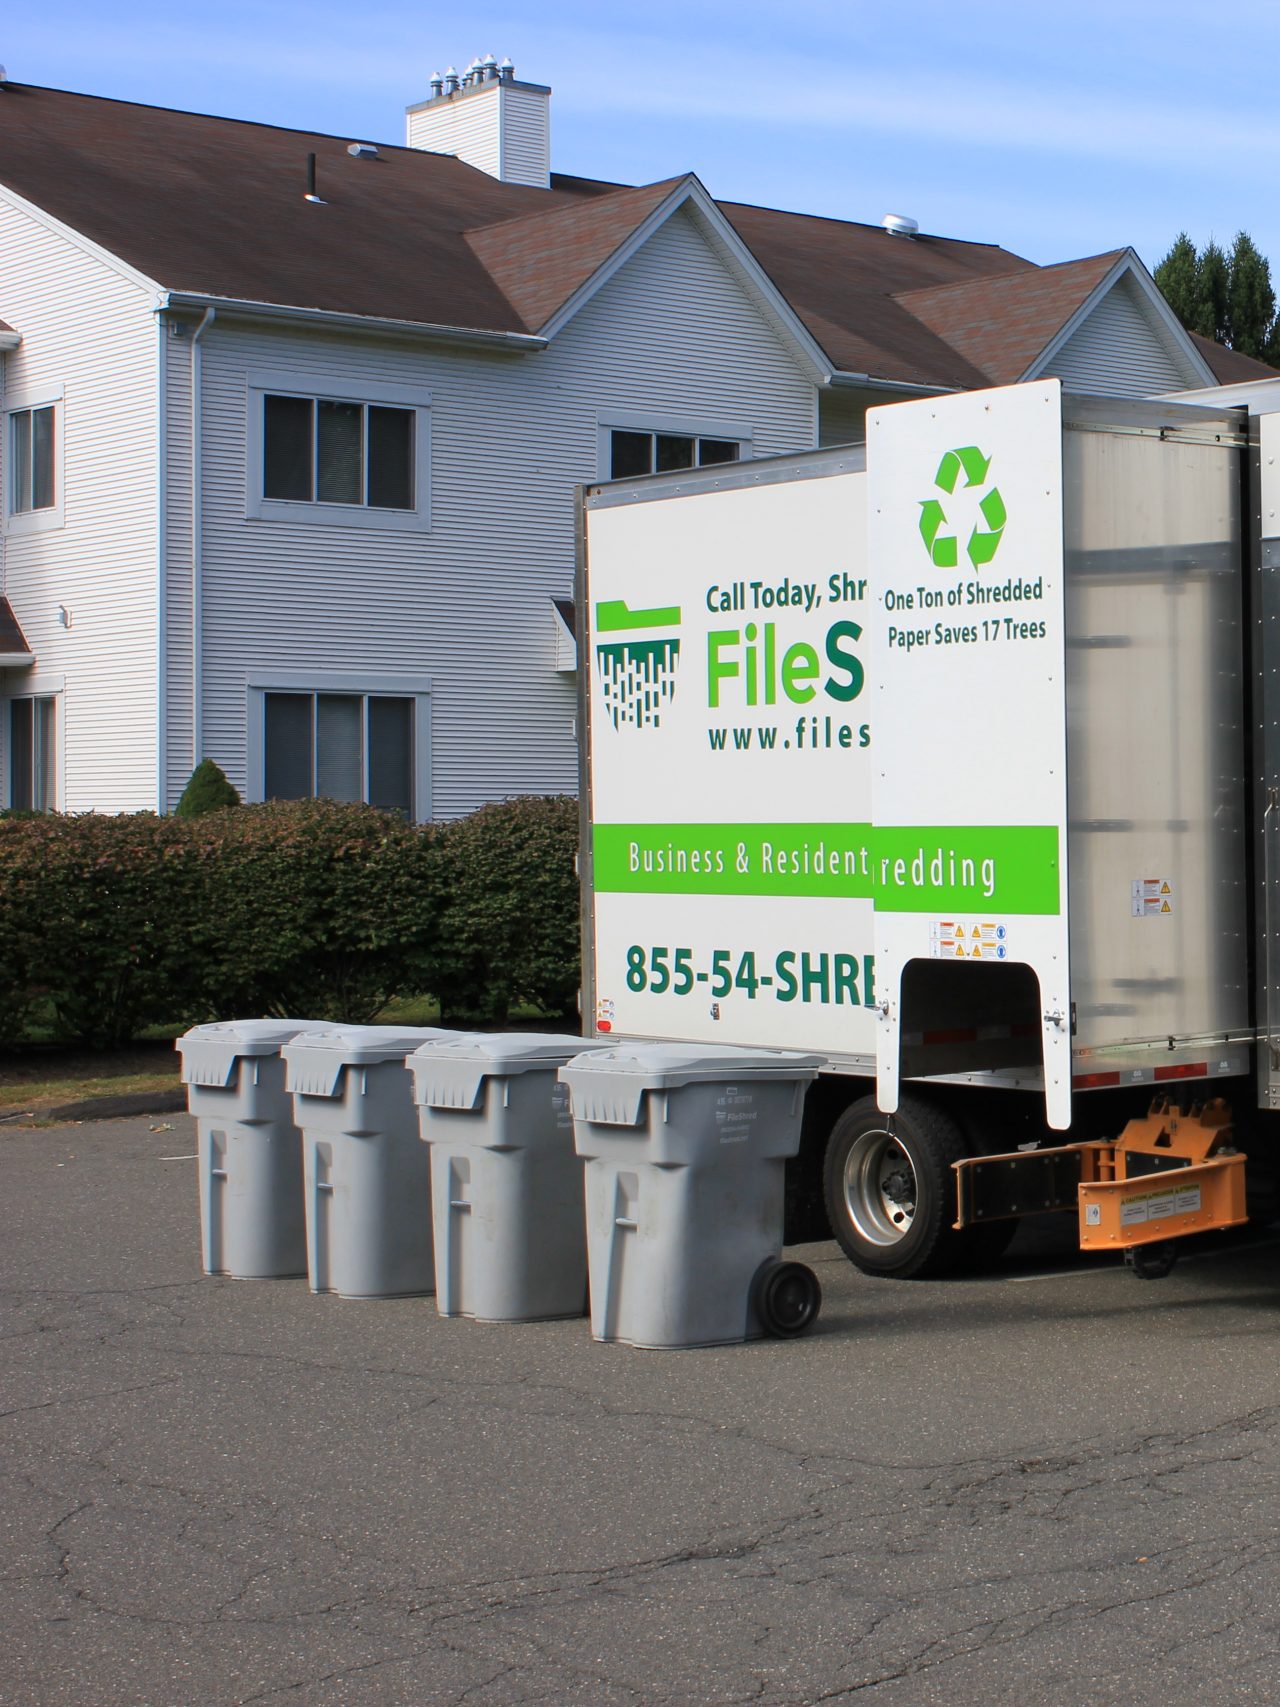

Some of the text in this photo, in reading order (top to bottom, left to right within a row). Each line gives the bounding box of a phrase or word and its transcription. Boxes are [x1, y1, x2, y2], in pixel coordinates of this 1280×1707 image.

[706, 572, 867, 612] Call Today, Shr
[885, 576, 1043, 611] One Ton of Shredded
[888, 617, 1046, 651] Paper Saves 17 Trees
[707, 621, 864, 708] FileS
[708, 716, 871, 750] www.files
[629, 842, 868, 875] Business & Resident
[873, 848, 995, 897] redding
